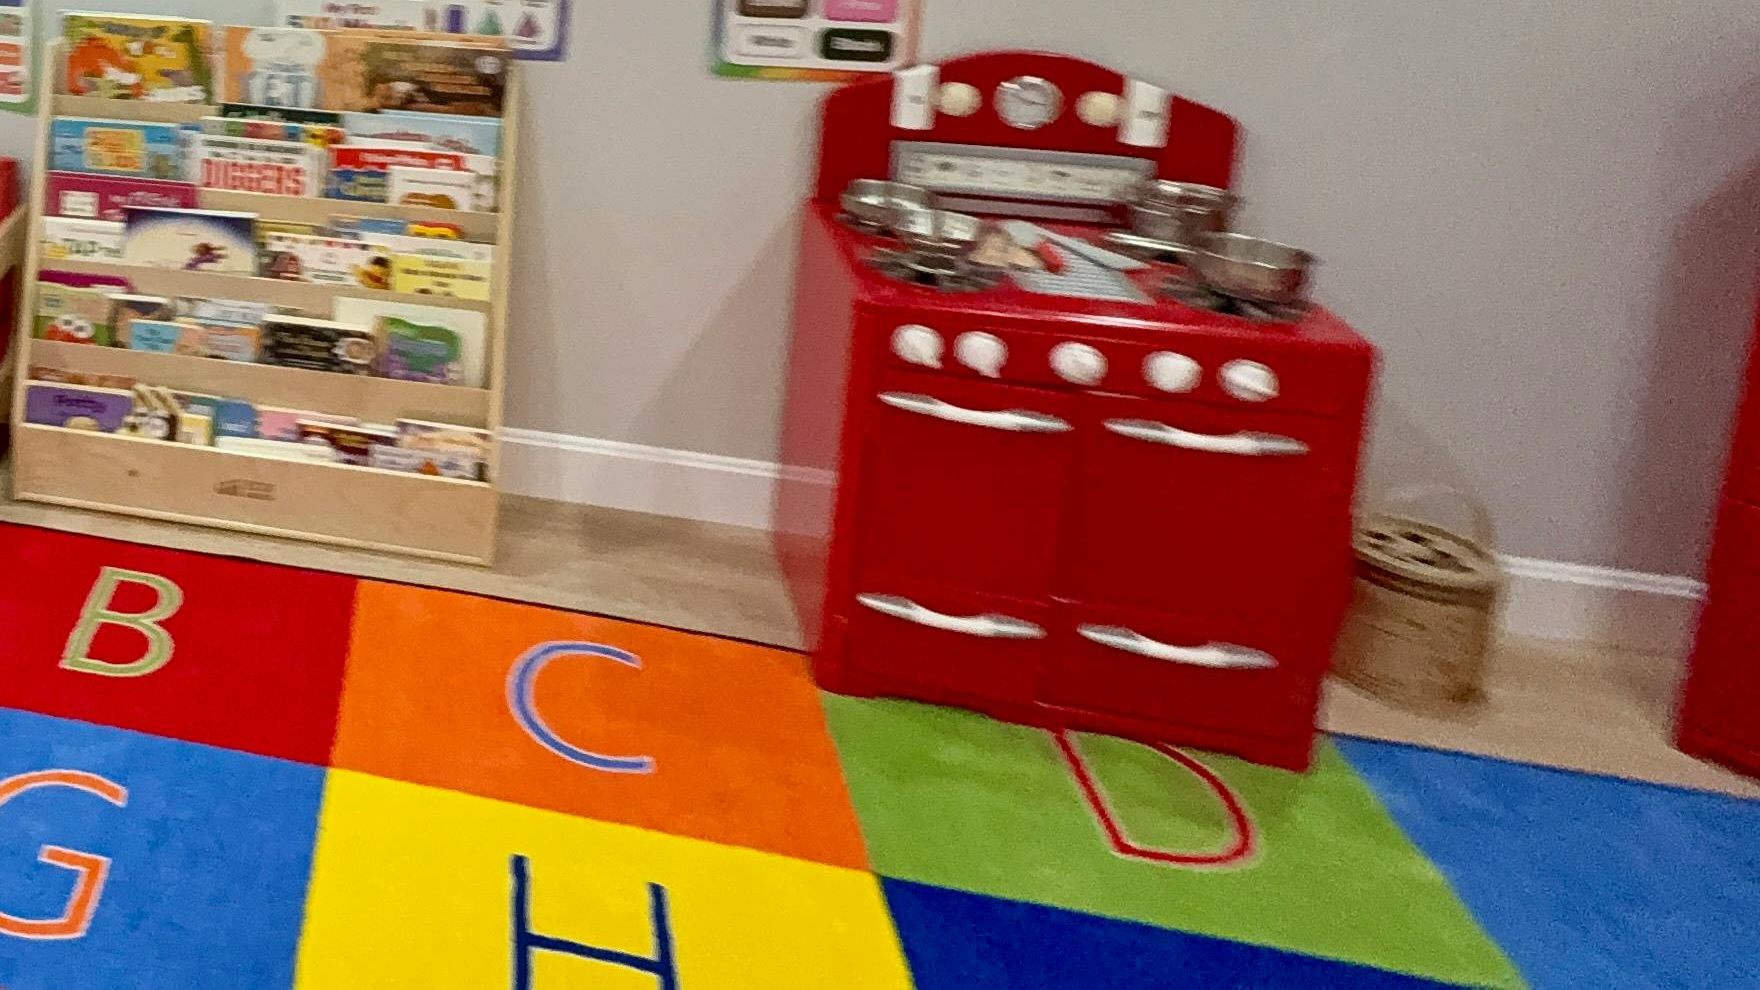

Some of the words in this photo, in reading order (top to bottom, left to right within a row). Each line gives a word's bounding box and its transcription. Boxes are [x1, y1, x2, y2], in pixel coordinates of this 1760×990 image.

[58, 566, 186, 678] B
[504, 640, 657, 775] C
[1043, 728, 1264, 872] D
[508, 853, 684, 990] H
